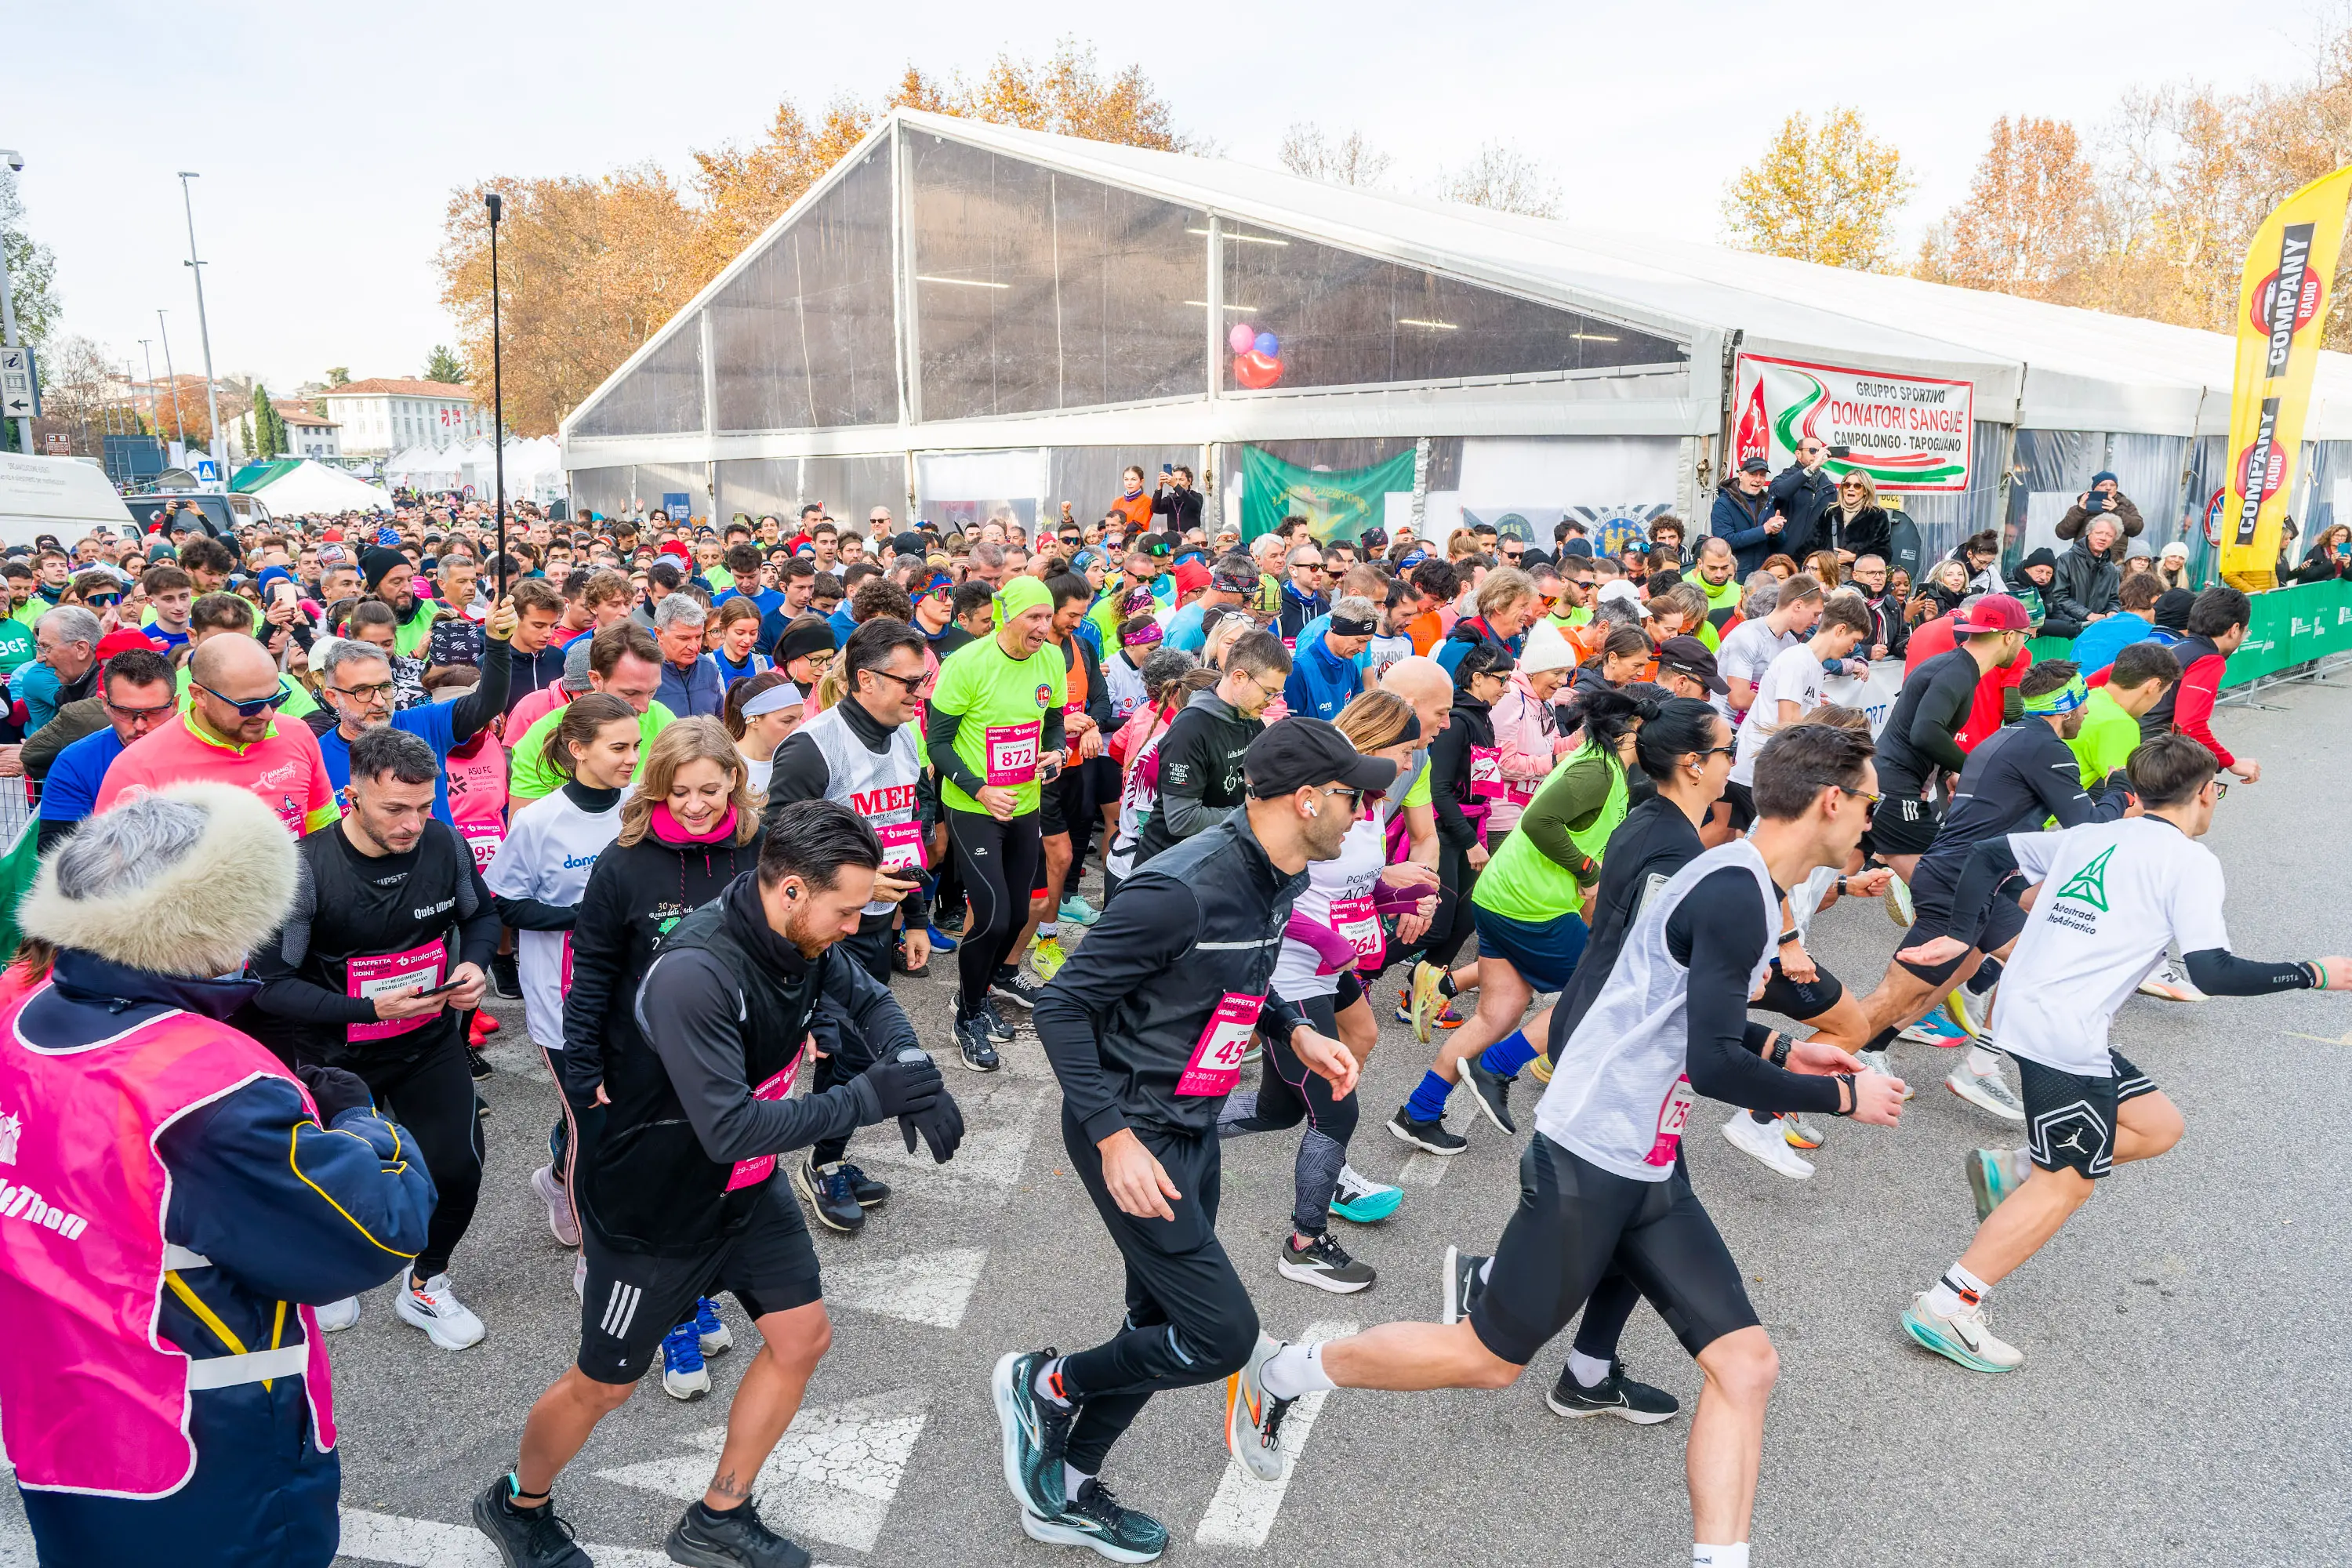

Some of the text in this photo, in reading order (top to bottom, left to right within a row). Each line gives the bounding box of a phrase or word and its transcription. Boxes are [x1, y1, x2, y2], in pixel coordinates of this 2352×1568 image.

[2269, 237, 2309, 367] COMPANY
[2299, 281, 2318, 319] RADIO
[1857, 381, 1945, 404] GRUPPO SPORTIVO
[1831, 401, 1963, 433] DONATORI SANGUE
[1834, 430, 1901, 448] CAMPOLONGO
[1909, 436, 1961, 452] TAPOGLIANO
[1740, 445, 1766, 461] 2011
[2238, 412, 2275, 535] COMPANY
[2265, 454, 2283, 490] RADIO
[1002, 748, 1032, 767] 872
[267, 766, 289, 779] AVIANO
[472, 844, 496, 862] 95
[414, 897, 456, 919] Quis Ultra?
[648, 911, 666, 920] Ronco
[658, 902, 667, 912] 30
[2047, 913, 2096, 935] ltoAdriatico
[353, 958, 391, 967] STAFFETTA
[410, 947, 442, 964] Biofarma
[390, 971, 423, 984] REGGIMENTO
[2273, 975, 2299, 983] KIPSTA
[375, 982, 408, 992] BERSAGLIERI
[1223, 1004, 1253, 1012] TELETHON
[1224, 996, 1256, 1007] STAFFETTA
[1185, 1072, 1217, 1081] 29-30/11
[756, 1076, 781, 1097] STAFFETTA
[735, 1159, 768, 1175] 29-30/11
